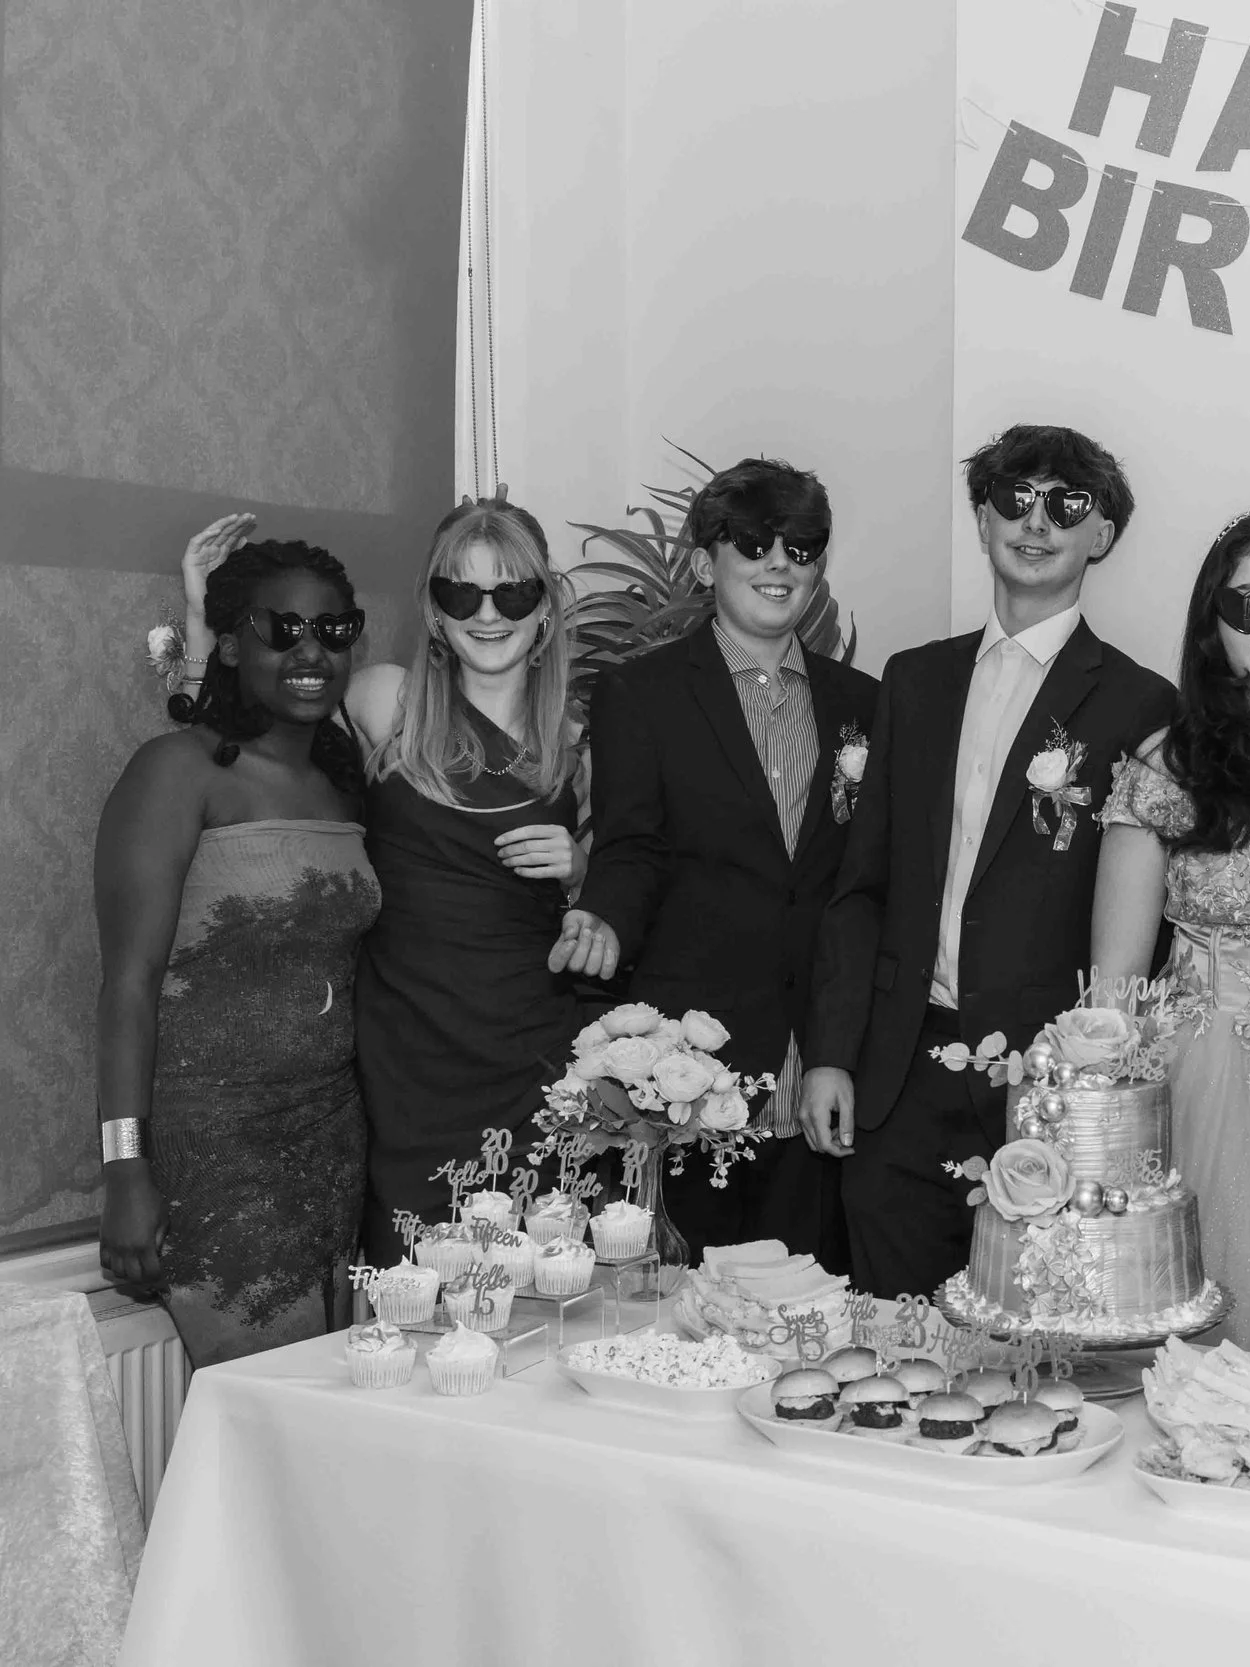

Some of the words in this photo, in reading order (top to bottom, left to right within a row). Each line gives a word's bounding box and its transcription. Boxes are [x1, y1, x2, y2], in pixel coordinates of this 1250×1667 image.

[481, 1127, 513, 1151] 20
[622, 1139, 649, 1165] 20
[508, 1167, 540, 1194] 20
[470, 1215, 522, 1253] Fifteen
[348, 1264, 422, 1303] Fift
[459, 1261, 513, 1291] Hello
[470, 1286, 495, 1316] 15
[840, 1288, 879, 1320] Hello
[894, 1292, 930, 1324] 20
